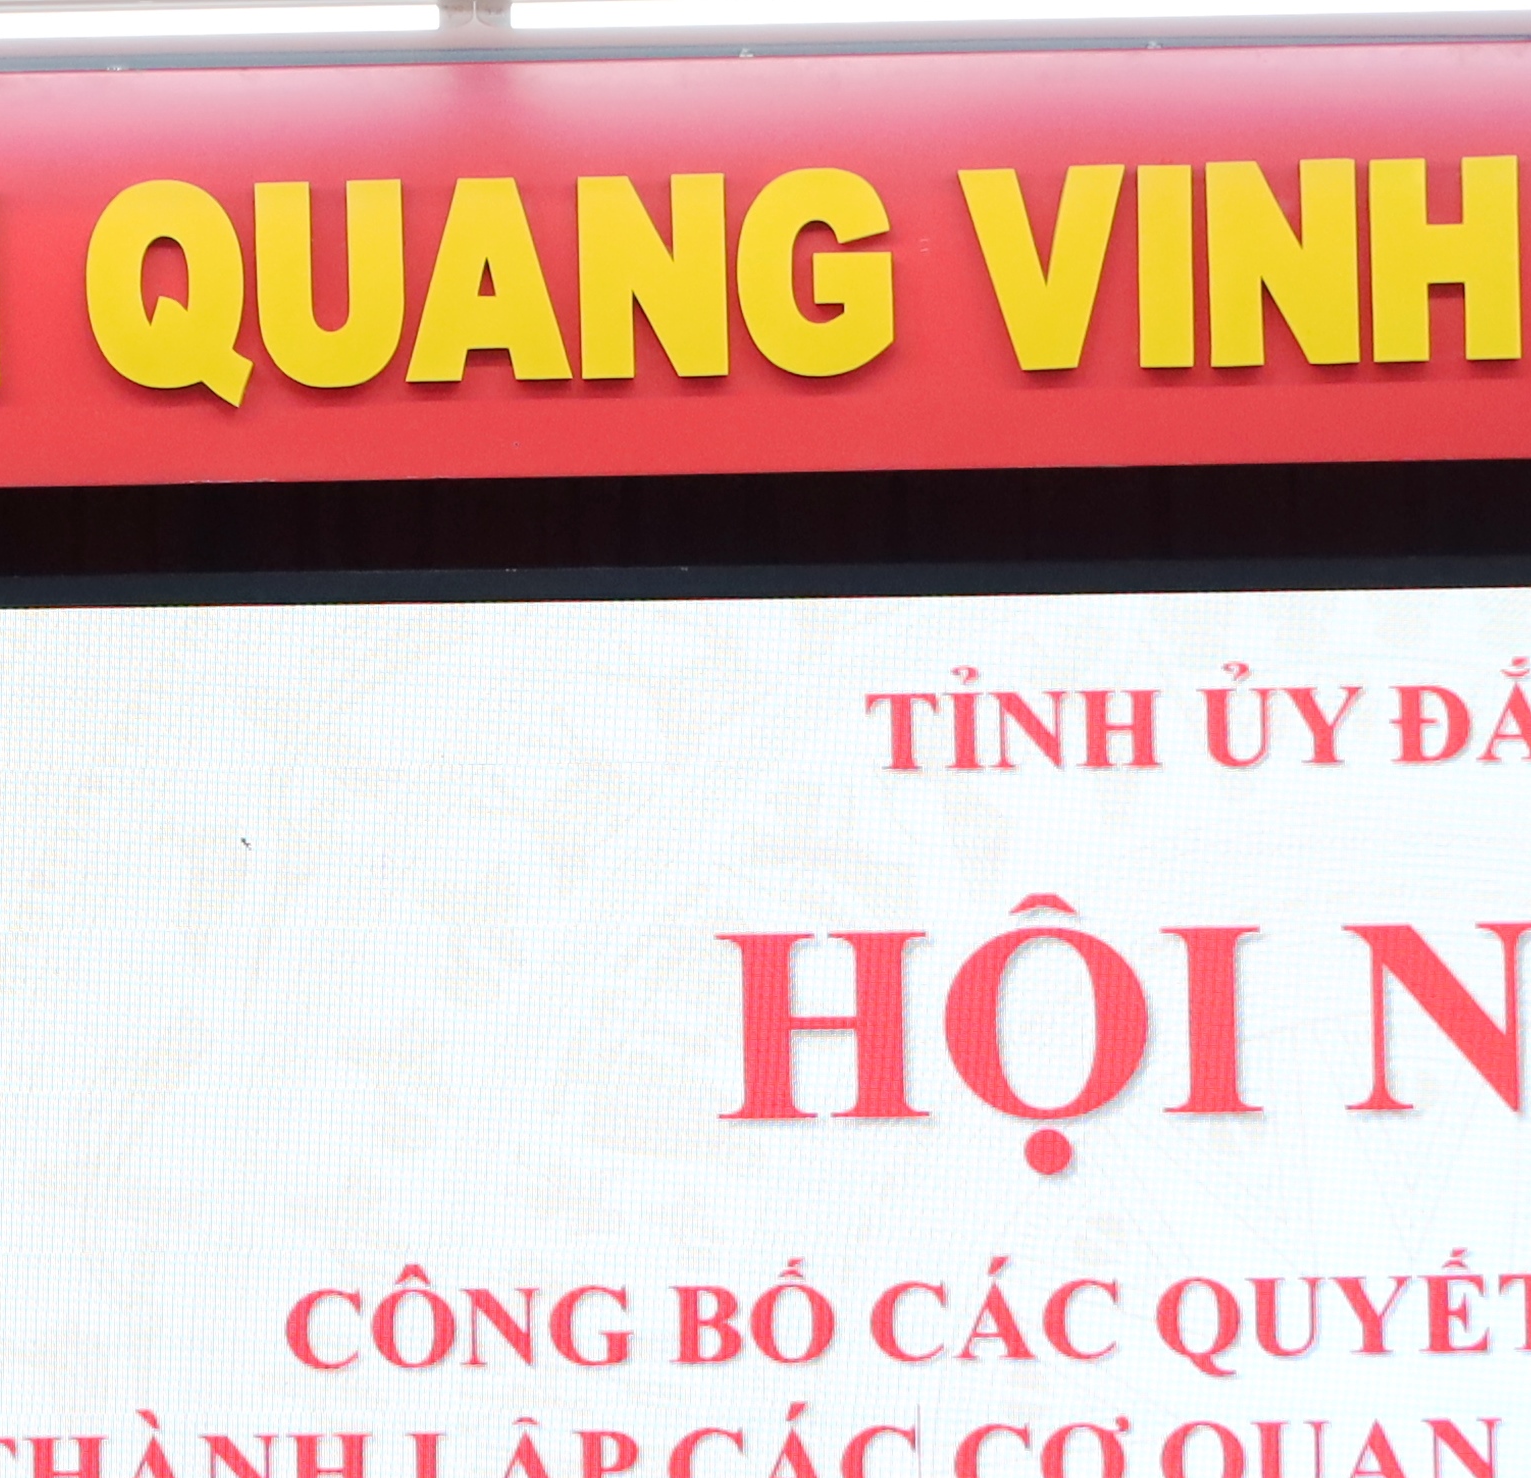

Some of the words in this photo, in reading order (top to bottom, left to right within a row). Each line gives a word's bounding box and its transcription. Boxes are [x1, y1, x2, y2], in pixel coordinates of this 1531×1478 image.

[86, 168, 895, 405] QUANG
[959, 156, 1523, 370] VINH
[866, 667, 1158, 771] TỈNH
[1203, 663, 1359, 767] ỦY
[716, 894, 1262, 1175] HỘI
[286, 1264, 631, 1370] CÔNG
[675, 1258, 835, 1364] BỐ
[871, 1257, 1118, 1362] CÁC
